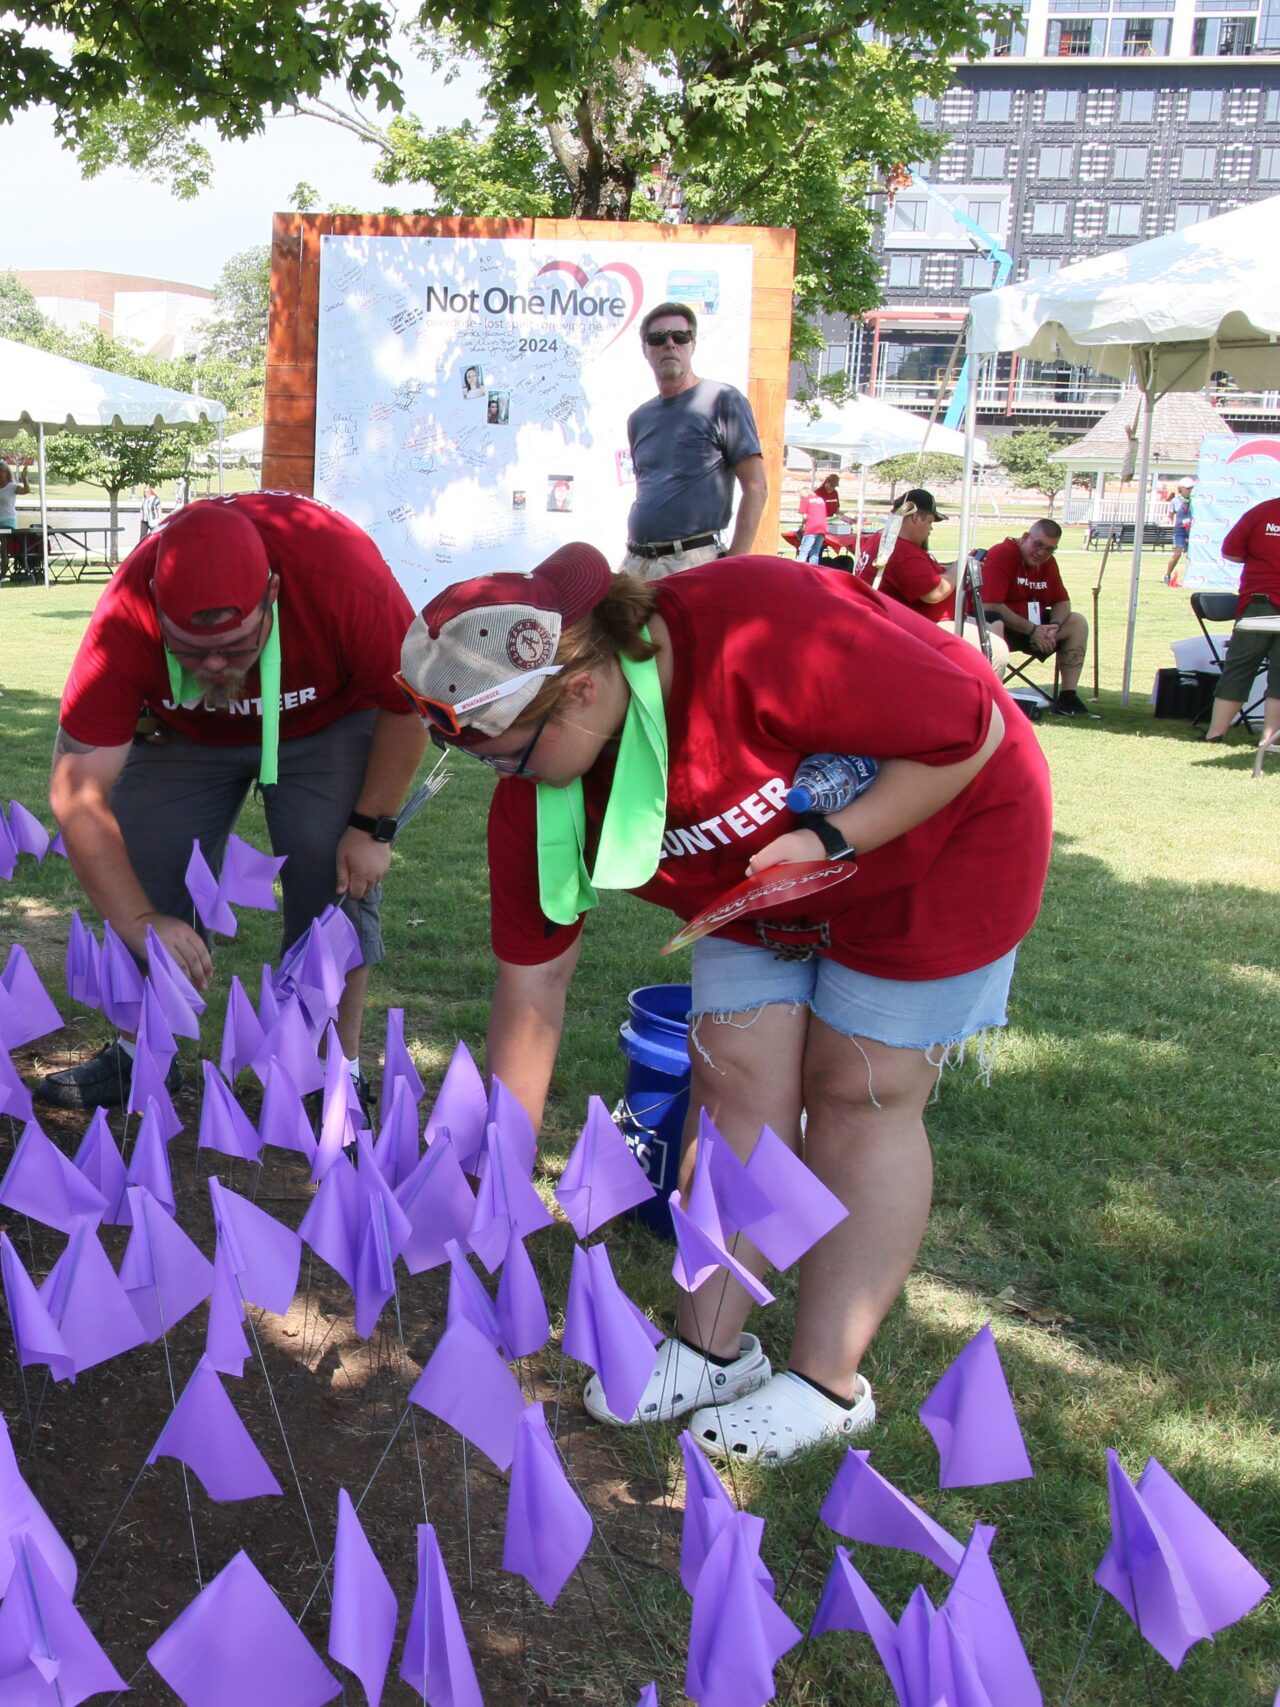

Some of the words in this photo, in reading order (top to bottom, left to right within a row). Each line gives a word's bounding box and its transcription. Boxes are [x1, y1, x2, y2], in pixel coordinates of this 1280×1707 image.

[426, 286, 479, 313] Not
[484, 287, 545, 315] One
[550, 288, 626, 317] More
[484, 317, 503, 328] lost
[518, 338, 559, 353] 2024
[660, 777, 793, 860] UNTEER
